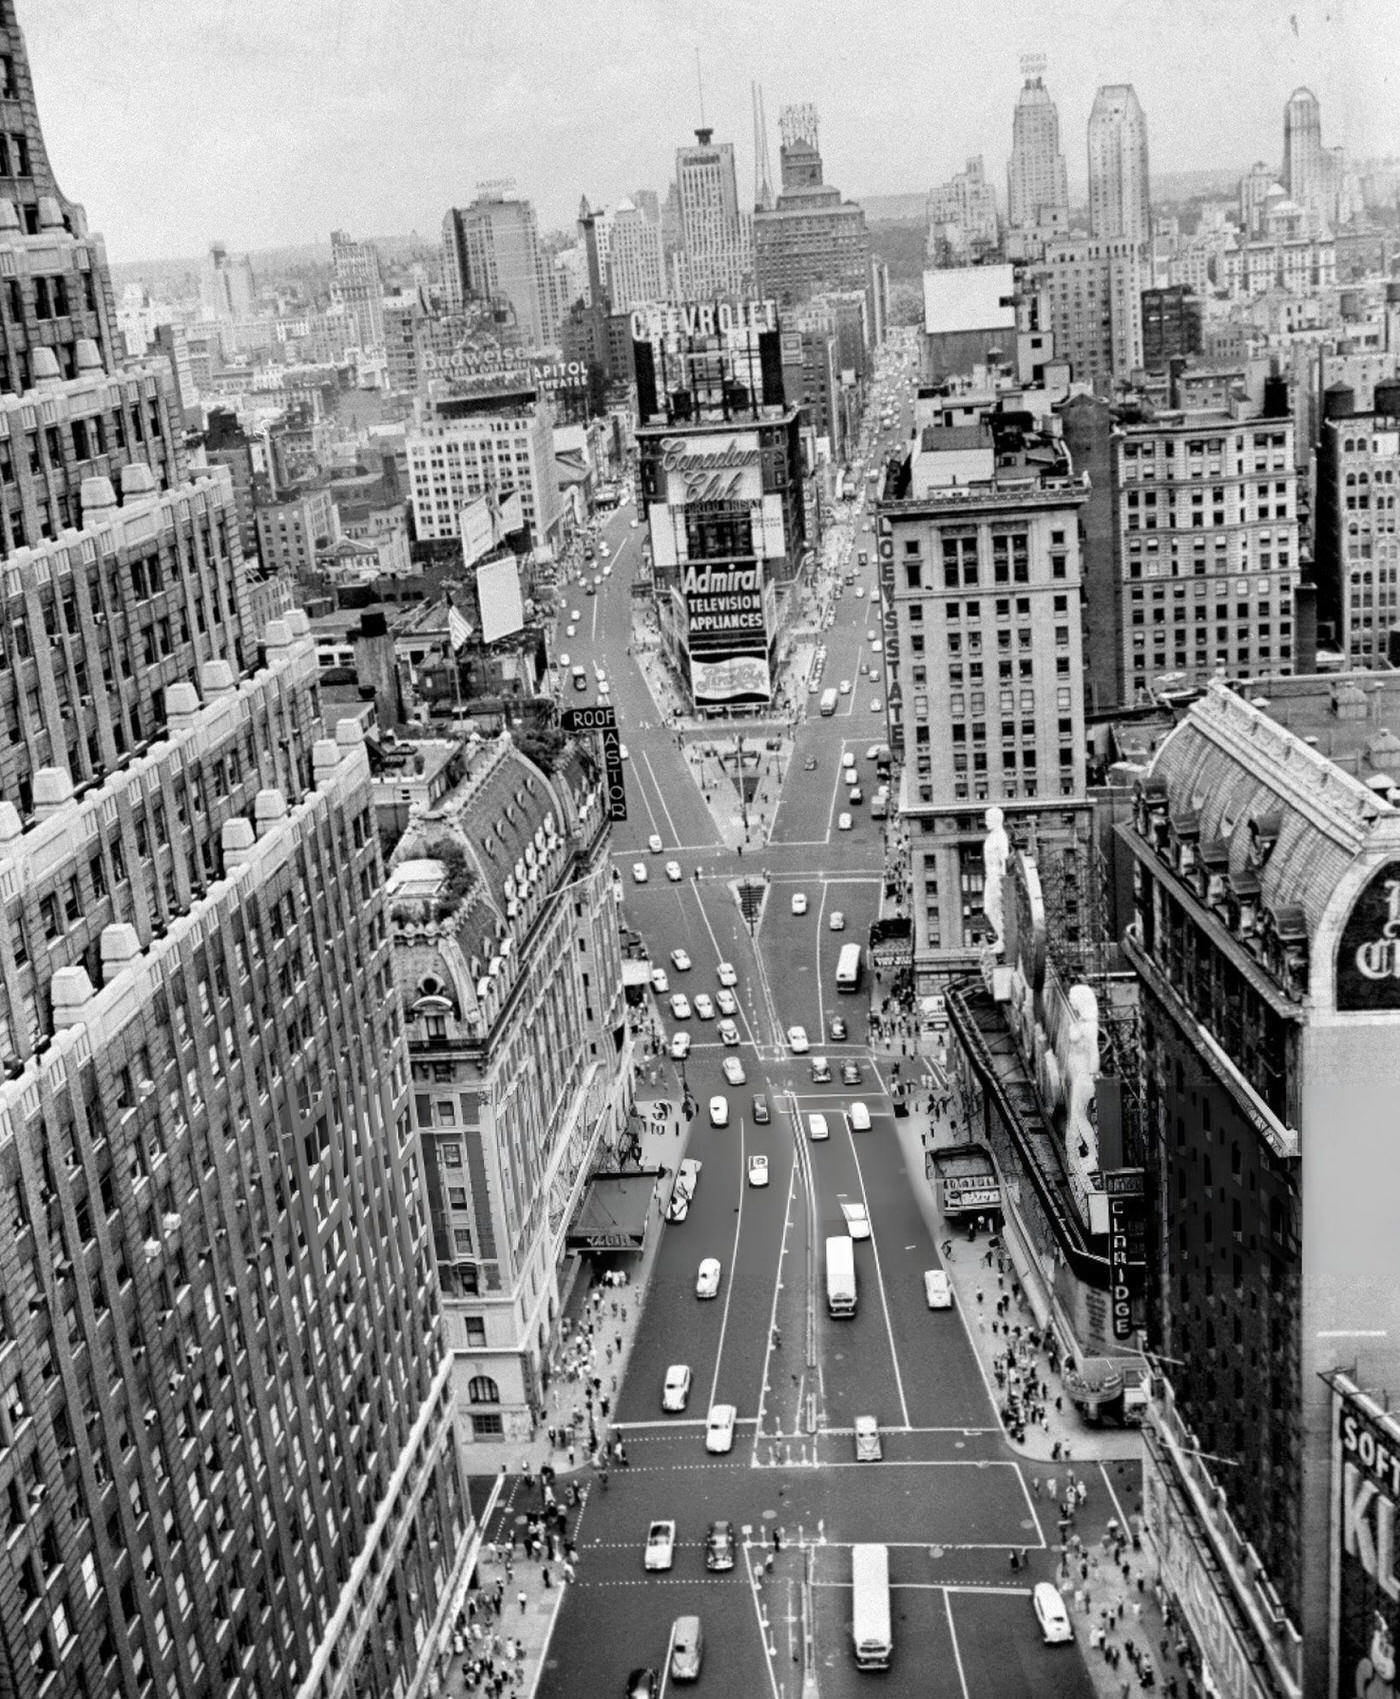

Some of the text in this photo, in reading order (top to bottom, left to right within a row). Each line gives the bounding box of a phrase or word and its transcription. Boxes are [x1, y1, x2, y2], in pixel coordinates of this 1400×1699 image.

[630, 300, 776, 342] CHEVROLET
[526, 361, 588, 379] APITOL
[539, 375, 588, 390] THEATRE
[660, 438, 760, 471] Canadian
[683, 471, 742, 502] Club
[682, 561, 763, 594] Admiral
[689, 594, 761, 613] TELEVISION
[690, 613, 763, 631] APPLIANCES
[886, 639, 905, 744] STATE
[573, 709, 614, 727] ROOF
[604, 731, 626, 818] ASTOR
[1112, 1200, 1130, 1334] CLARIDGE
[1344, 1416, 1400, 1497] SOFT
